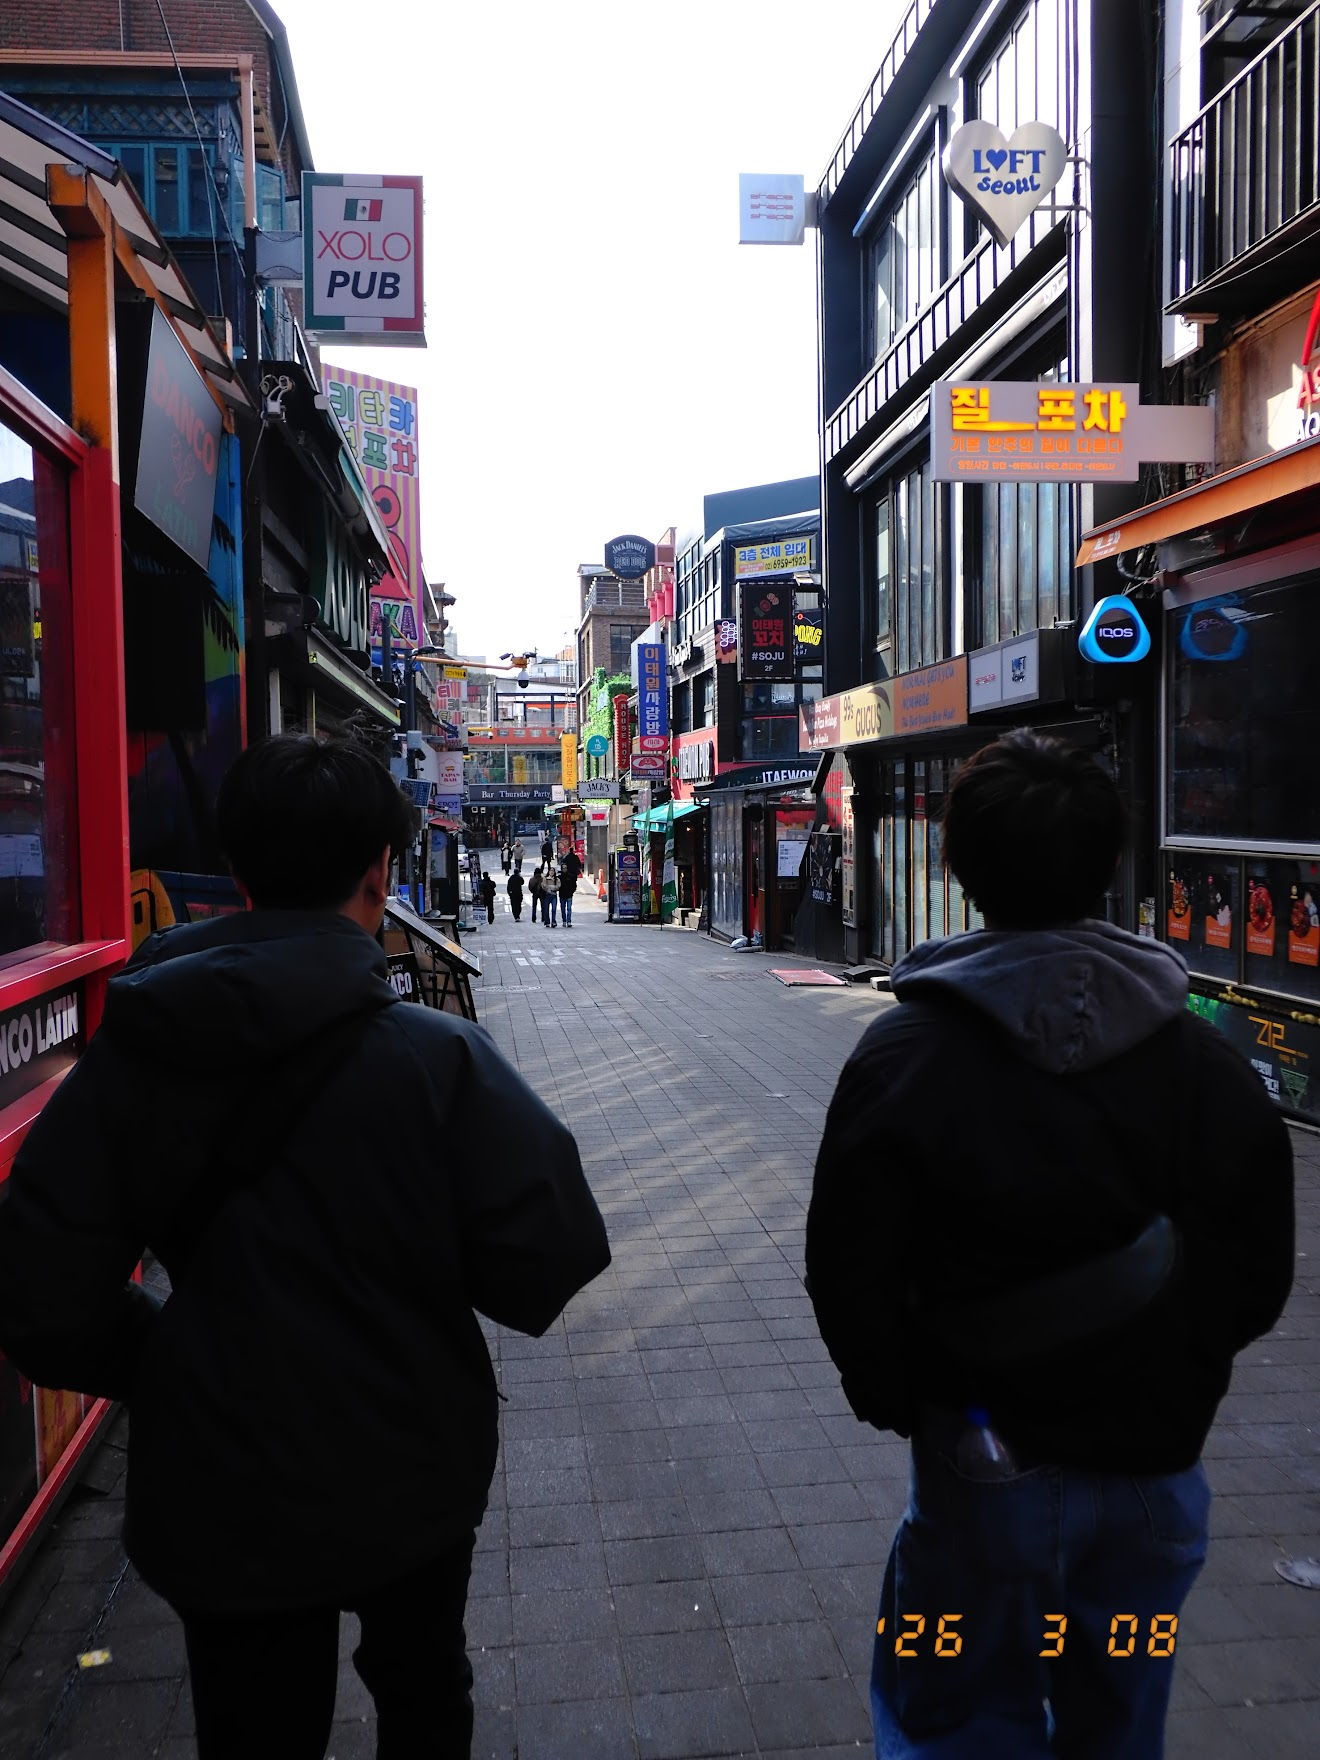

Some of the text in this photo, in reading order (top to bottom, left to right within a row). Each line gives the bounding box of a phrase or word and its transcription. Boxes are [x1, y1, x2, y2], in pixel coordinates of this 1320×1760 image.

[317, 230, 412, 262] XOLO
[326, 270, 401, 299] PUB
[151, 354, 215, 476] DANCO
[1037, 388, 1127, 433] 포차
[612, 543, 626, 554] JACK
[739, 542, 806, 562] 3층 전체 임대
[773, 556, 807, 570] 6959-1923
[752, 619, 784, 632] 이태원
[1098, 627, 1134, 639] IQOS
[753, 631, 784, 647] 꼬치
[751, 652, 785, 661] #SOJU
[644, 647, 661, 736] 이태원사랑방
[855, 702, 882, 737] GUGUS
[482, 790, 494, 798] Bar
[499, 790, 531, 799] Thursday
[534, 790, 551, 799] Party
[587, 782, 611, 792] JACK'S
[35, 991, 79, 1055] LATIN
